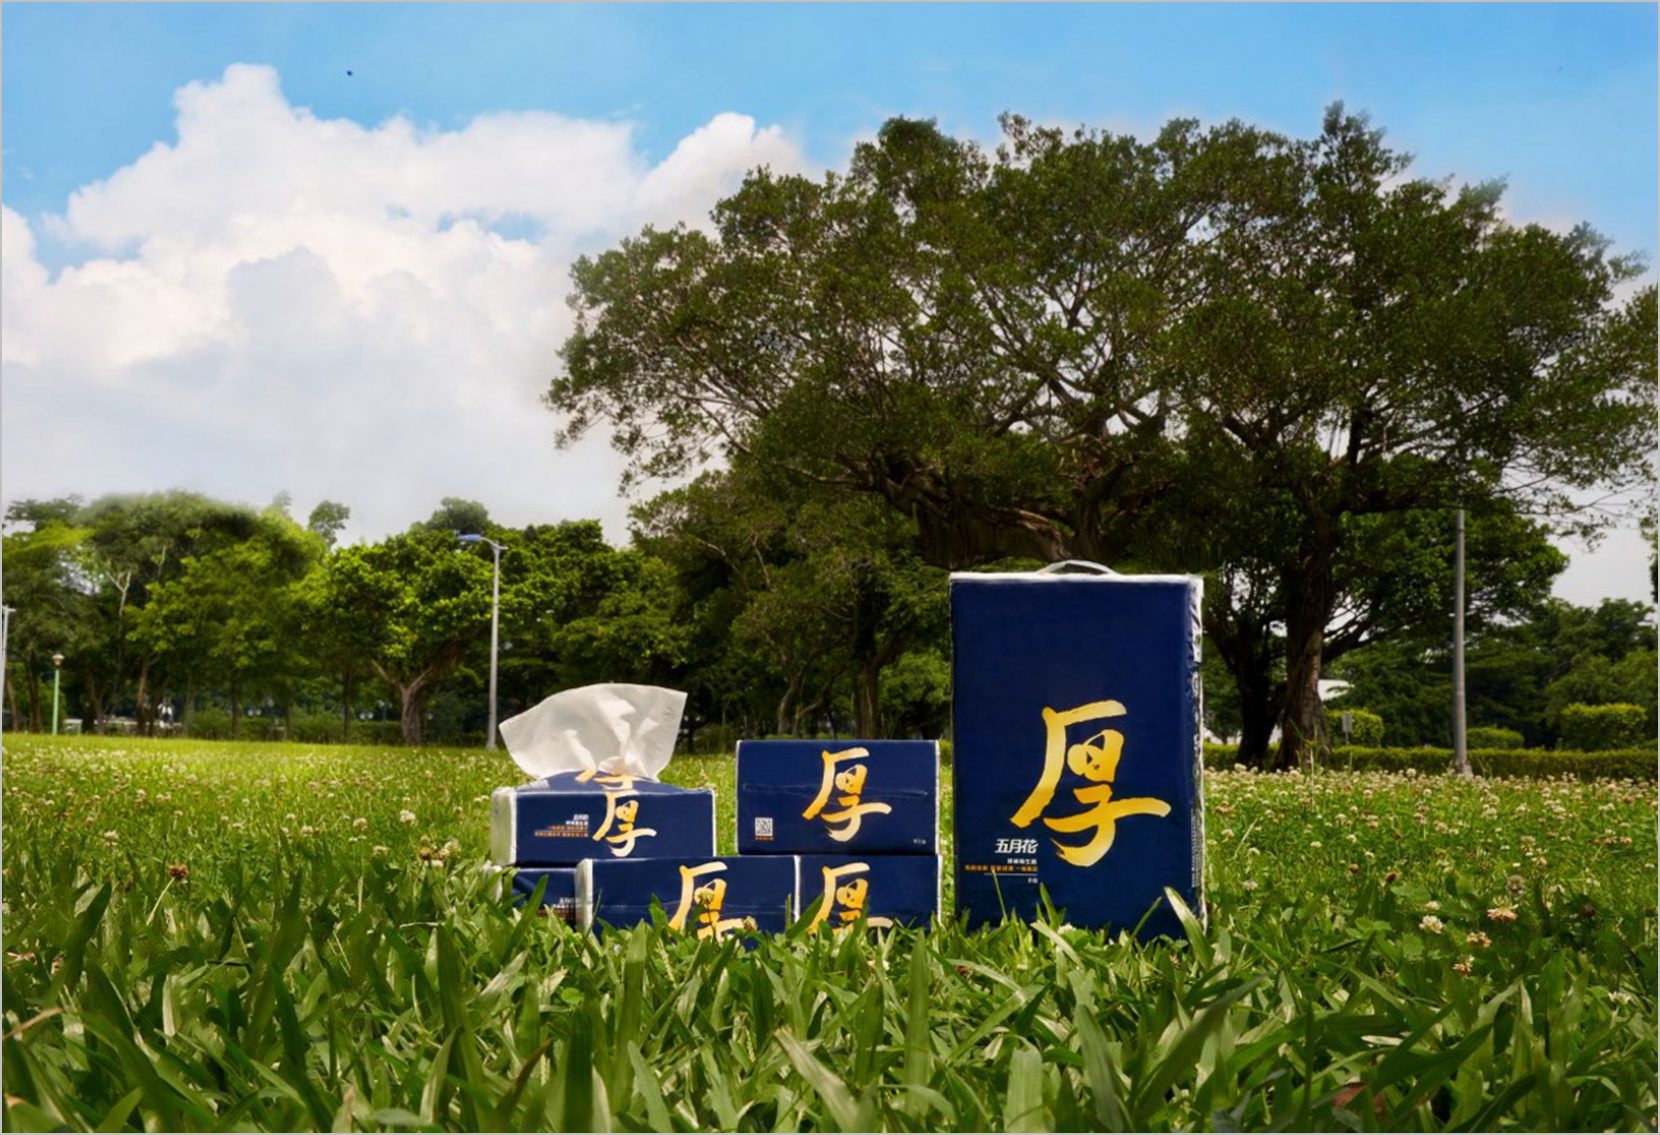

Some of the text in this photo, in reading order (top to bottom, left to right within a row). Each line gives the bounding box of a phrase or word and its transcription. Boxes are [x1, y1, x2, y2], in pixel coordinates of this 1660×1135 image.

[592, 788, 657, 857] 厚
[803, 747, 892, 841] 厚
[1010, 700, 1171, 867] 厚
[994, 838, 1039, 853] 五月花
